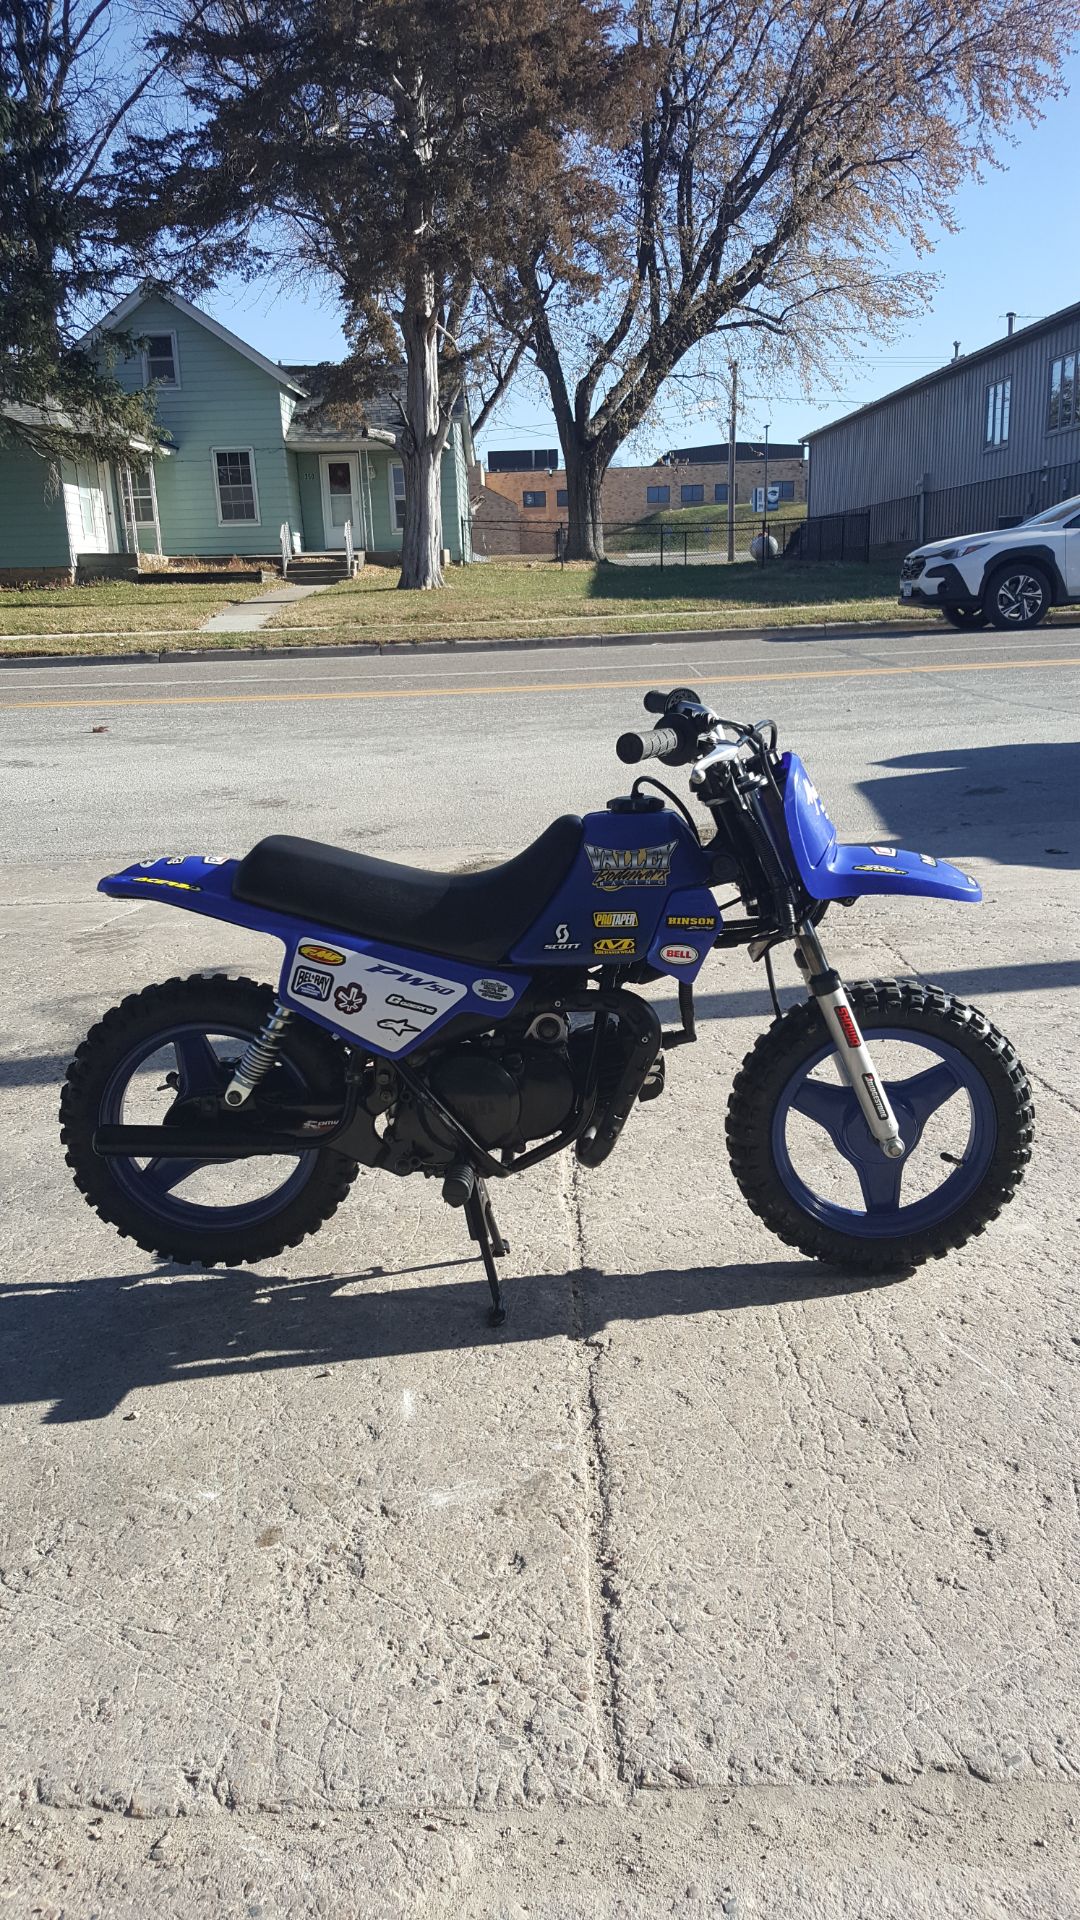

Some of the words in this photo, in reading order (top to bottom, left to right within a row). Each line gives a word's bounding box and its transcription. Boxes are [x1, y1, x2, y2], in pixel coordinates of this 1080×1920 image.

[584, 840, 678, 869] VALLEY
[666, 949, 691, 958] BELL
[364, 964, 455, 995] PW50
